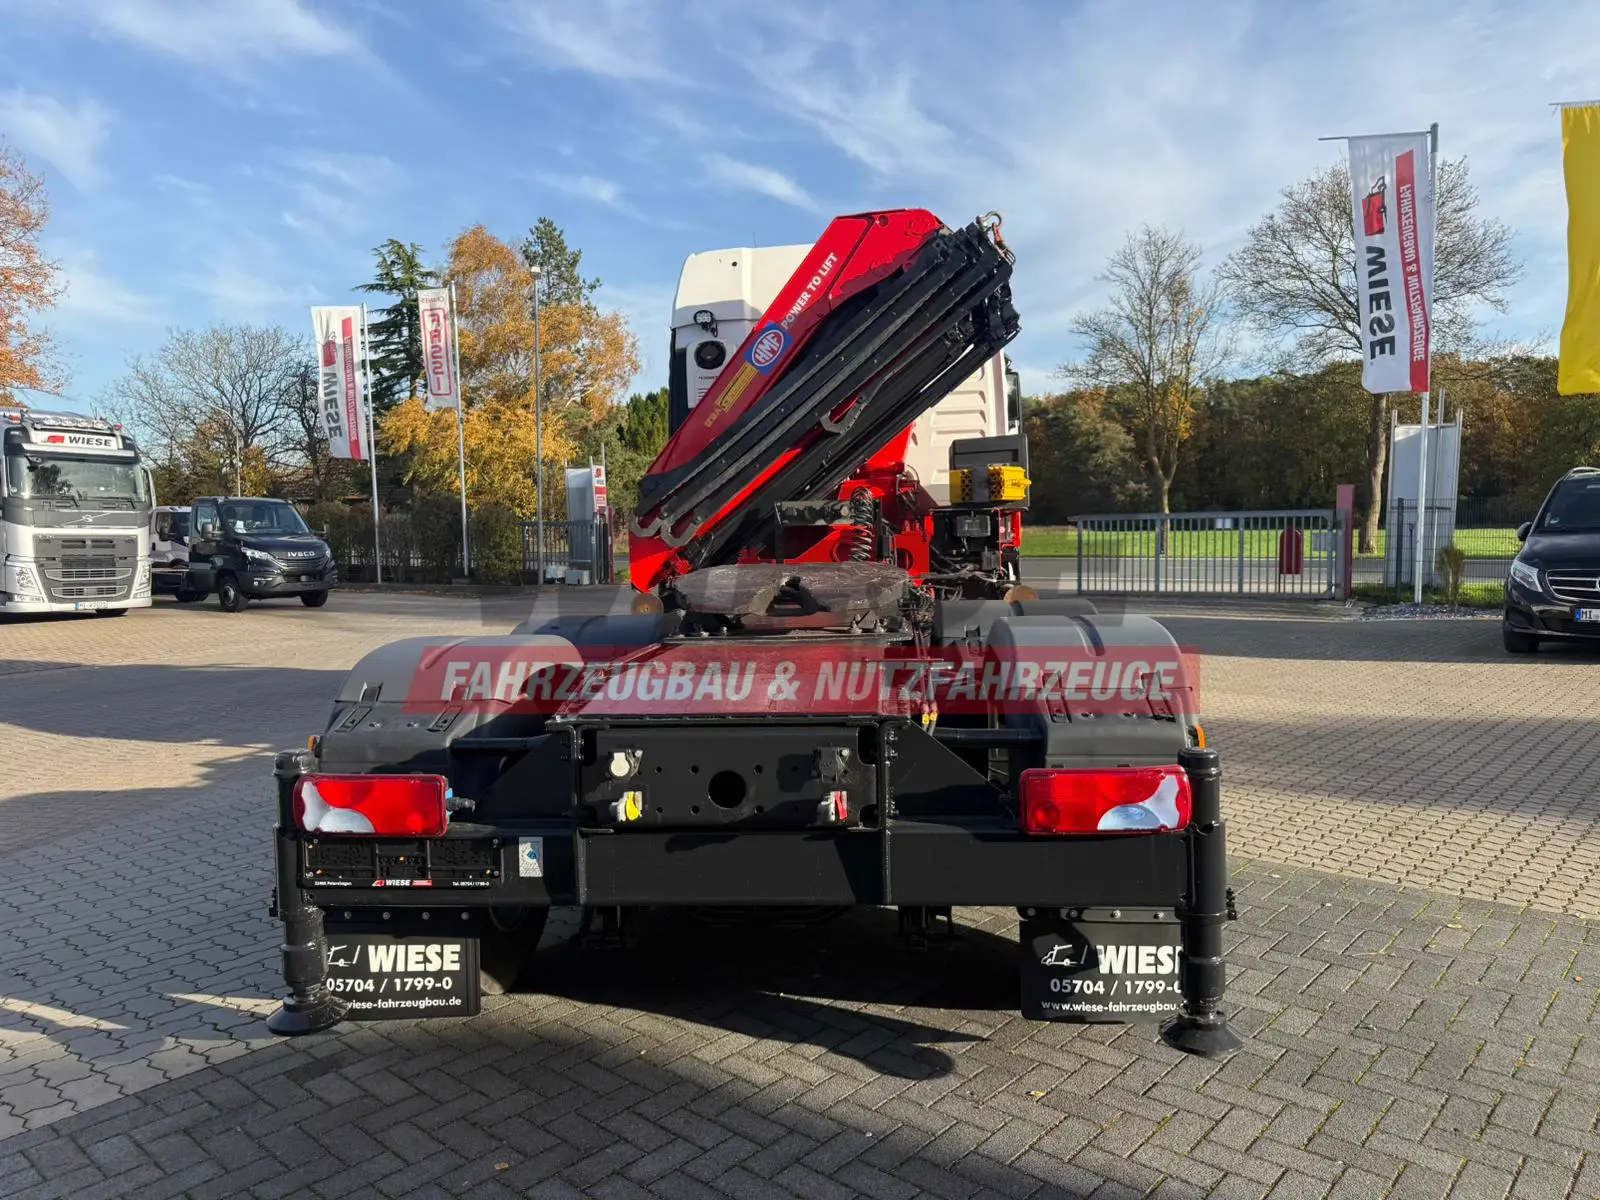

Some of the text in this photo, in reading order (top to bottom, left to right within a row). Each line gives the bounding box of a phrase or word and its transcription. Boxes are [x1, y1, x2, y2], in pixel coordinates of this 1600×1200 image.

[781, 252, 838, 331] POWER TO LIFT
[754, 333, 781, 364] HMF
[69, 436, 112, 447] WIESE
[1581, 610, 1592, 620] MI
[367, 944, 461, 972] WIESE
[326, 977, 453, 993] 05704 / 1799-0
[1050, 979, 1105, 994] 05704
[1110, 980, 1119, 996] /
[1041, 1001, 1180, 1013] www.wiese-fahrzeugbau.
